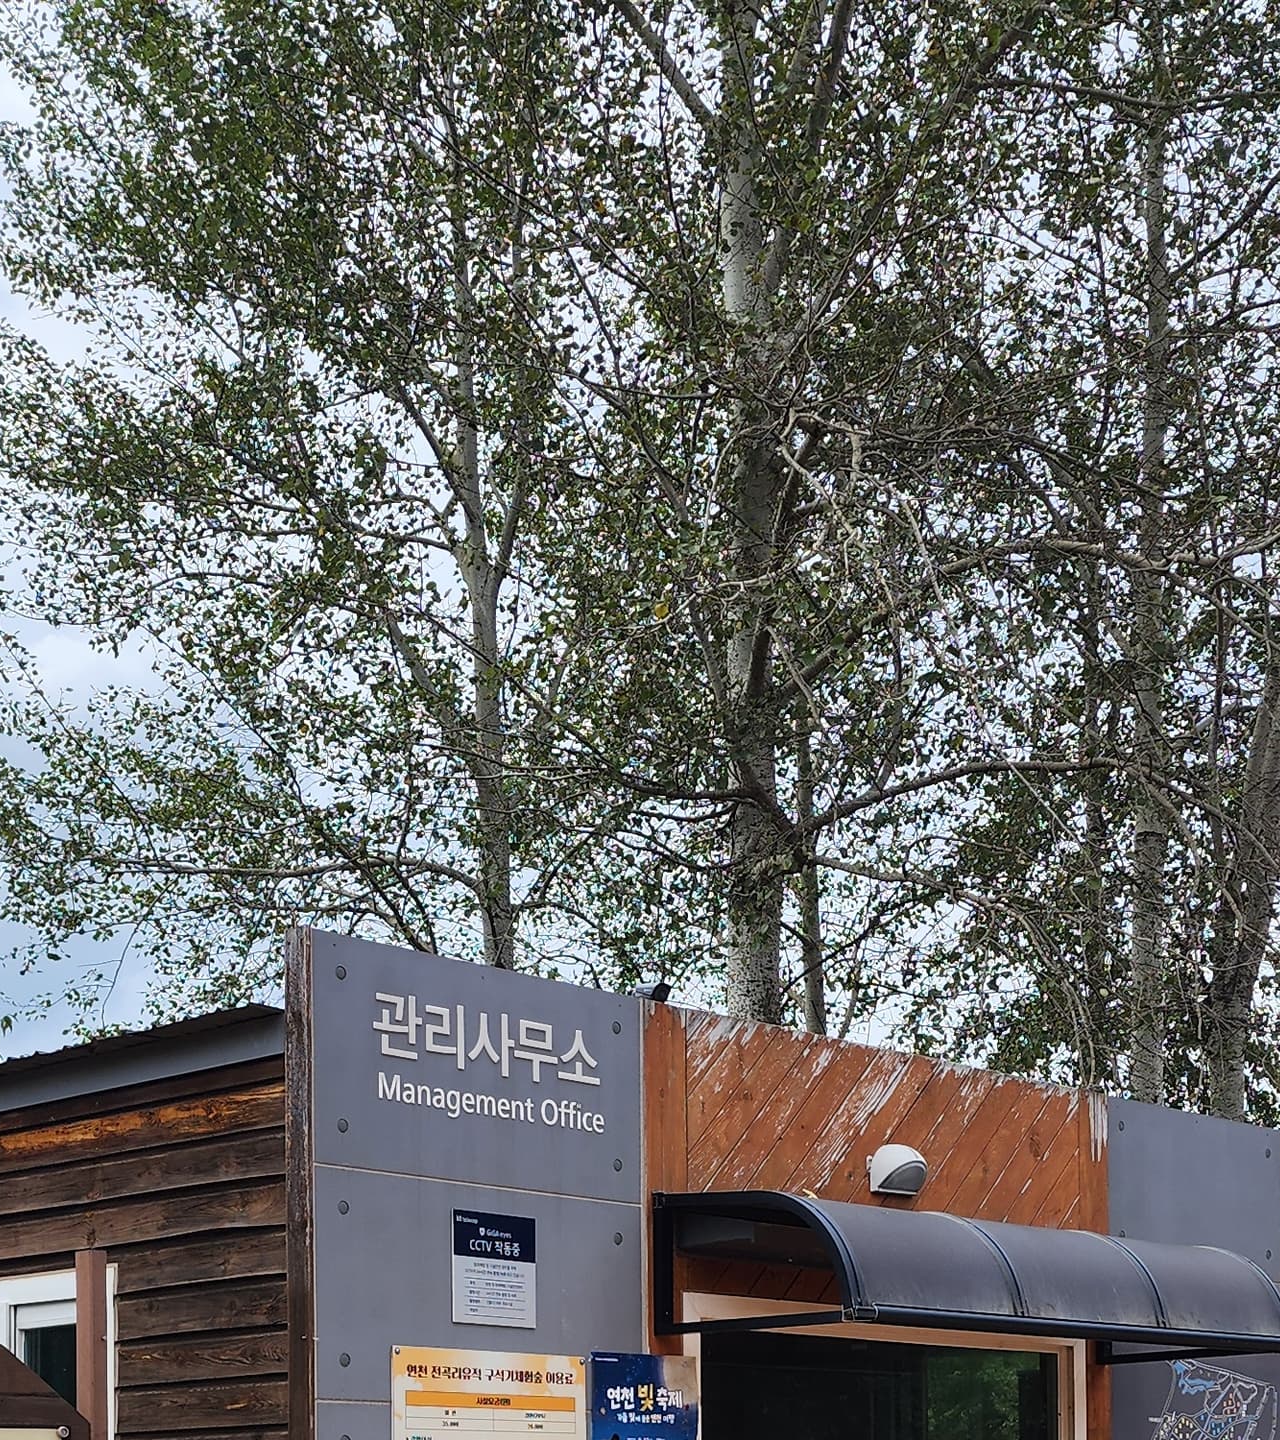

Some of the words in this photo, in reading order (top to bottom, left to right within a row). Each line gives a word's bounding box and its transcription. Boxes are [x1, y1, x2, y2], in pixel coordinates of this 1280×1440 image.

[372, 992, 601, 1086] 관리사무소
[377, 1071, 535, 1124] Management
[540, 1099, 606, 1134] Office
[469, 1239, 492, 1253] CCTV
[494, 1240, 521, 1257] 작동중
[406, 1364, 428, 1379] 연천
[546, 1371, 574, 1385] 이용료
[606, 1385, 635, 1410] 연천
[637, 1383, 654, 1412] 빛
[655, 1386, 683, 1412] 축제
